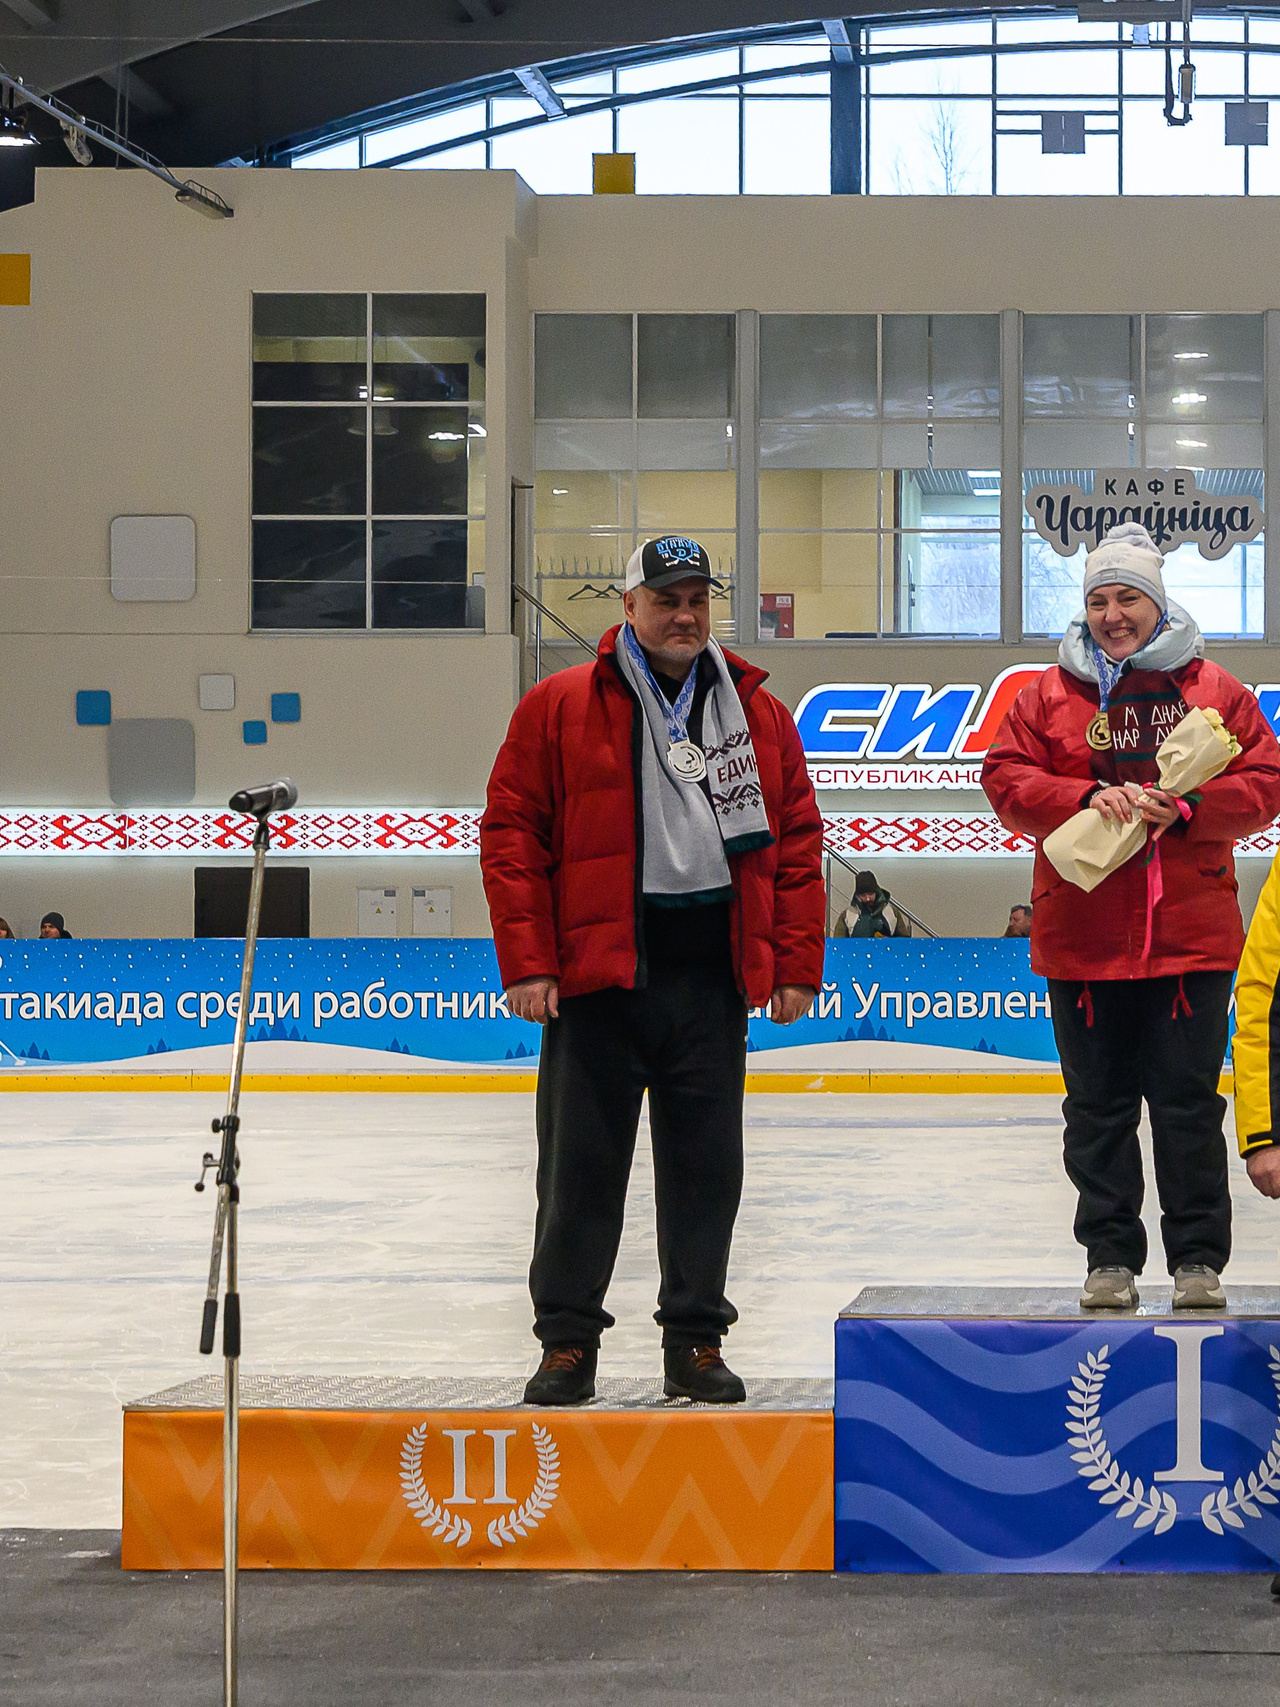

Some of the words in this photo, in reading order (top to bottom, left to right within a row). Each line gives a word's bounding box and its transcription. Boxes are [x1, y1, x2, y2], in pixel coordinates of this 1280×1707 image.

[1104, 478, 1186, 496] КАФЕ
[176, 991, 301, 1029] среди
[312, 981, 512, 1029] работник
[852, 982, 1053, 1029] Управлен
[1153, 1325, 1225, 1482] I
[441, 1429, 518, 1505] II
